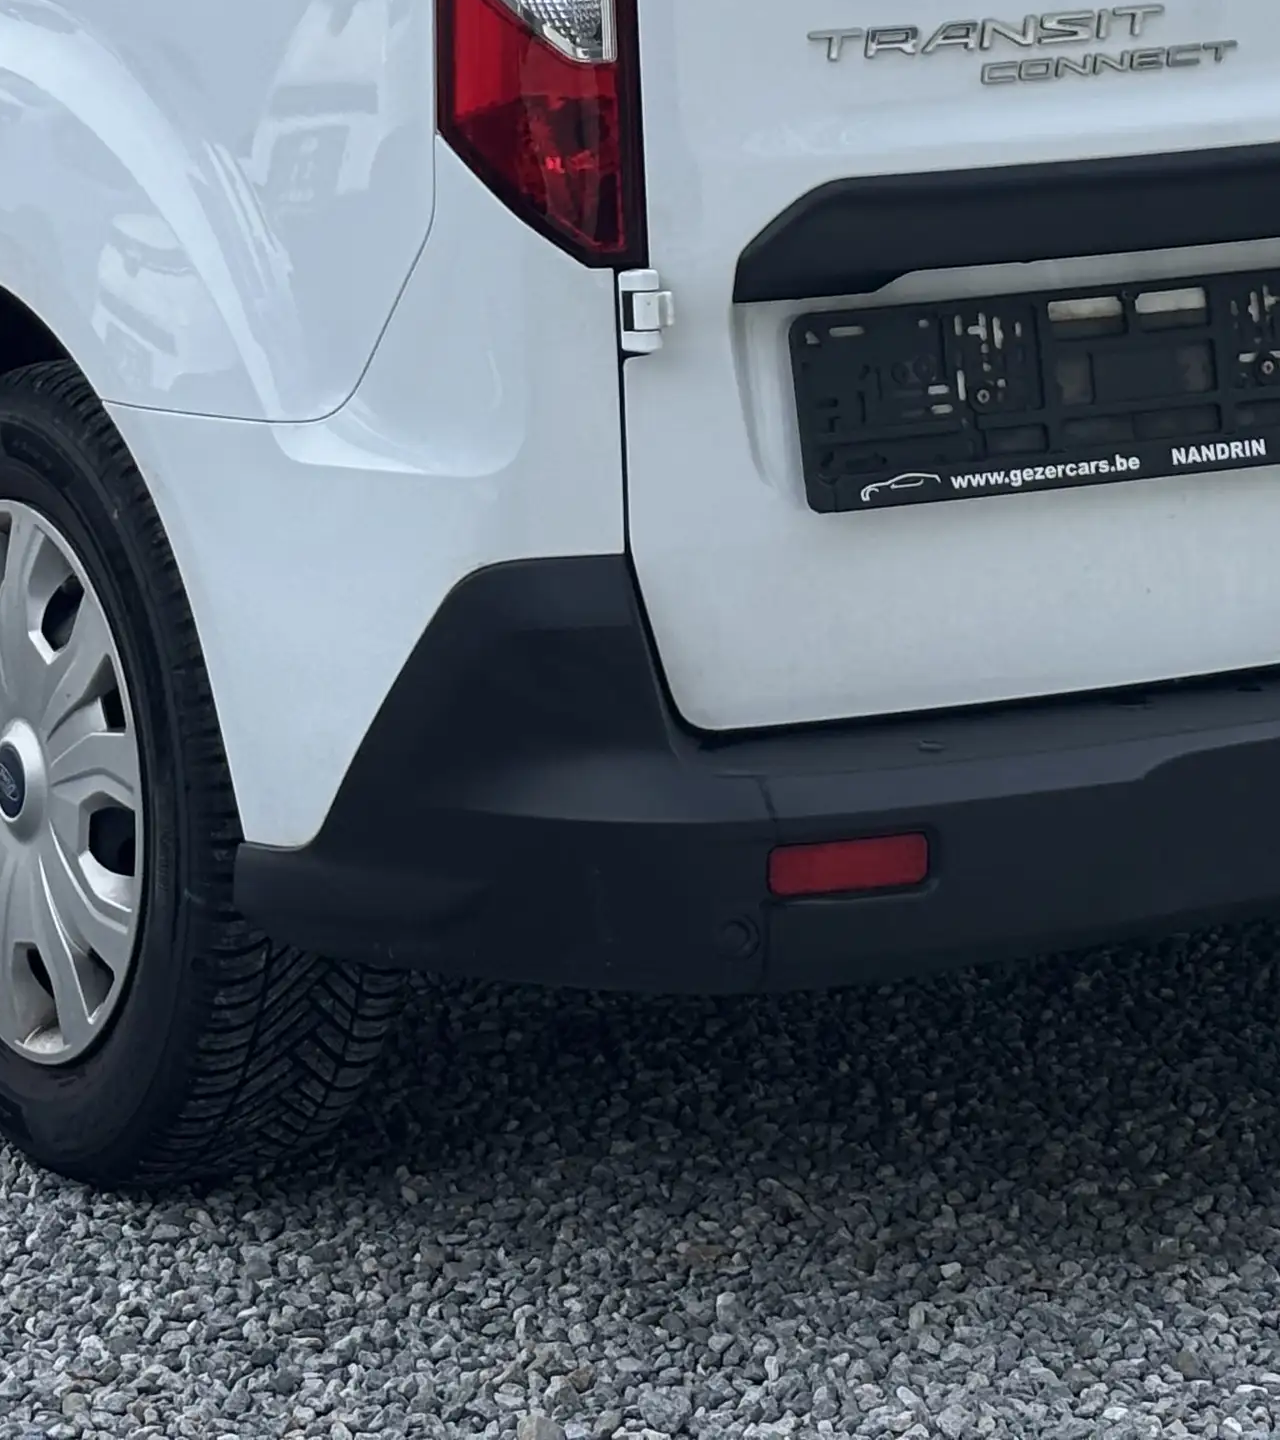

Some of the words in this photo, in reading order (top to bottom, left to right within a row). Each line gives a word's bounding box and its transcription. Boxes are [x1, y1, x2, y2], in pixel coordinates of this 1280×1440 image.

[807, 3, 1165, 62] TRANSIT
[980, 39, 1239, 86] CONNECT
[949, 453, 1141, 490] www.gezercars.be
[1170, 438, 1267, 466] NANDRIN
